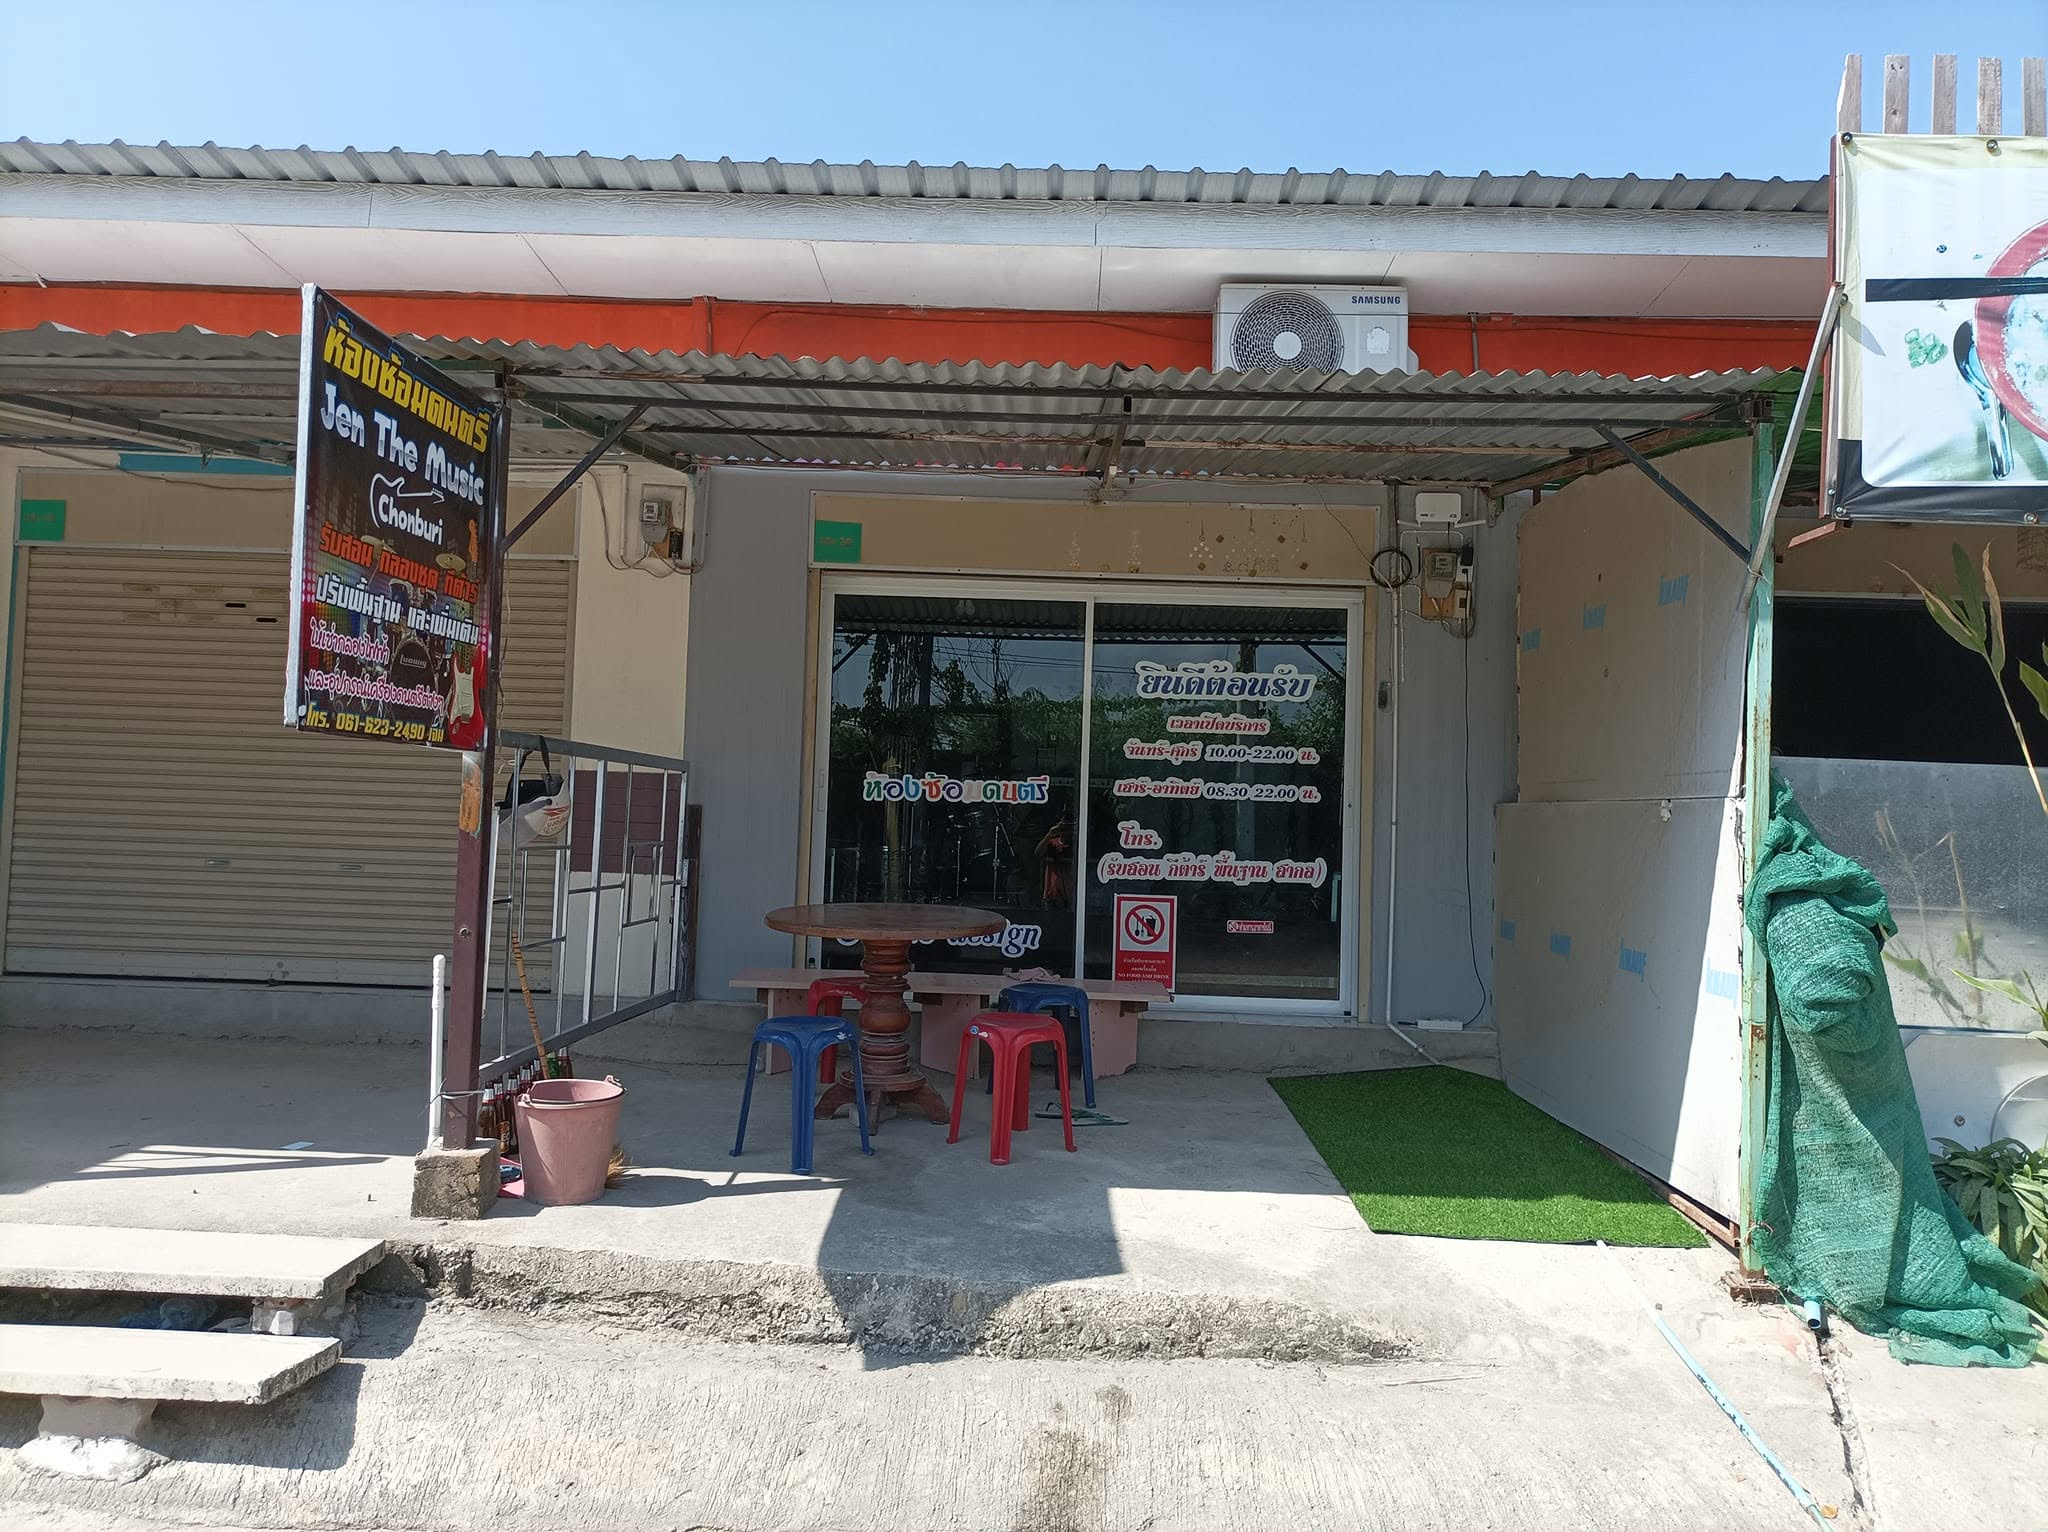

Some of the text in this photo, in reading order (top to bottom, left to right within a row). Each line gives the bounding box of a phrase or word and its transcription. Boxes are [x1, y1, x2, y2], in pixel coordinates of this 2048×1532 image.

[1351, 295, 1402, 305] SAMSUNG
[322, 315, 491, 454] ห้องซ้อมดนตรี
[320, 382, 486, 506] Jen The Music
[378, 494, 443, 546] Chonburi
[319, 521, 374, 568] รับสอน
[378, 550, 440, 593] กลองชุด
[316, 572, 481, 646] ปรับพื้นฐาน และเพิ่มเติม
[1138, 662, 1314, 700] ยินดีต้อนรับ
[305, 703, 330, 729] โทร.
[335, 711, 426, 741] 061-623-2490
[1169, 714, 1268, 734] เวลาเปิดบริการ
[1208, 747, 1295, 761] 10.00-22.00
[1300, 750, 1317, 762] น.
[864, 771, 1049, 803] ห้องซ้อมดนตรี
[1205, 785, 1249, 799] 08.30
[1253, 787, 1297, 800] 22.00
[1301, 788, 1319, 801] น.
[1119, 825, 1159, 847] โทร.
[1100, 856, 1162, 881] (รับสอน
[1213, 854, 1269, 881] พื้นฐาน
[1274, 860, 1323, 884] สากล)
